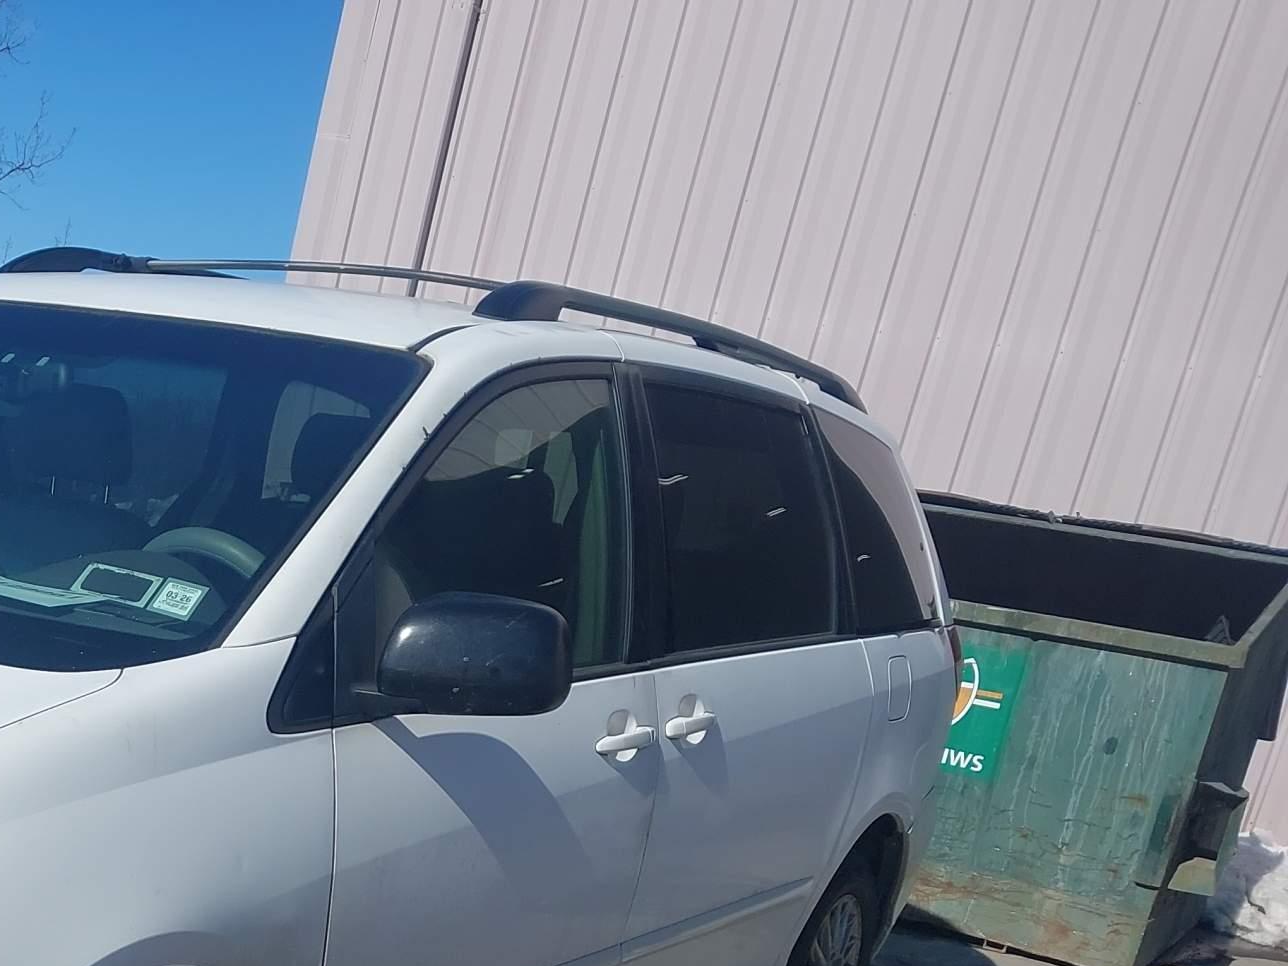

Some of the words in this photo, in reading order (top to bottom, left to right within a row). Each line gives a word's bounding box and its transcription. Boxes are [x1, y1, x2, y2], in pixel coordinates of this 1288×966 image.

[166, 590, 179, 600] 03
[180, 594, 193, 603] 26
[941, 745, 985, 772] IWS
